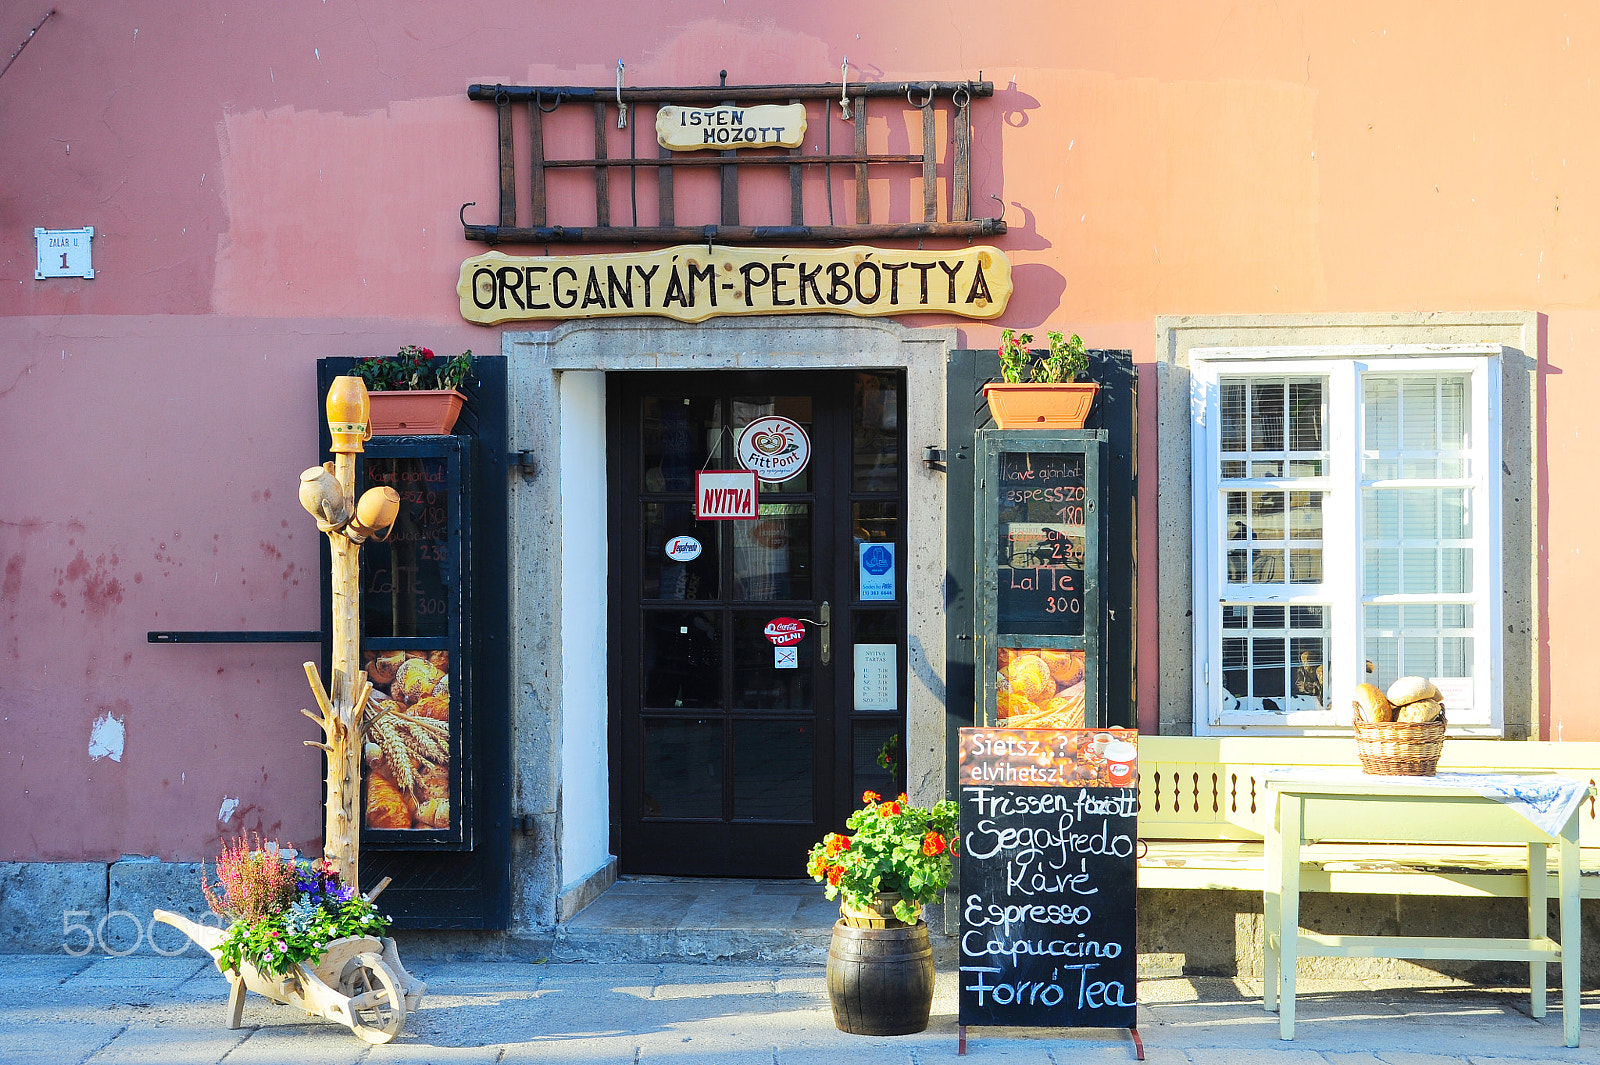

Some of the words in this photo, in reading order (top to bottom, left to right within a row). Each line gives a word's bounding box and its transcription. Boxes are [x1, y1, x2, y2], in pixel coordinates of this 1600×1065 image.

[681, 111, 744, 126] ISTEN
[703, 127, 785, 143] HOZOTT
[60, 253, 69, 269] 1
[703, 488, 751, 514] NYITVA
[1056, 505, 1084, 527] 180
[1052, 543, 1084, 559] 230
[418, 598, 446, 614] 300
[1046, 597, 1080, 613] 300
[770, 632, 802, 645] TOLNI
[971, 762, 1064, 782] elvihetsz!
[963, 787, 1074, 818] Frissen
[966, 813, 1133, 869] Segafredo
[1007, 857, 1099, 896] Kávé
[964, 894, 1092, 938] Espresso
[961, 931, 1123, 968] Capuccino
[960, 966, 1065, 1007] Forró
[1064, 963, 1137, 1010] Tea
